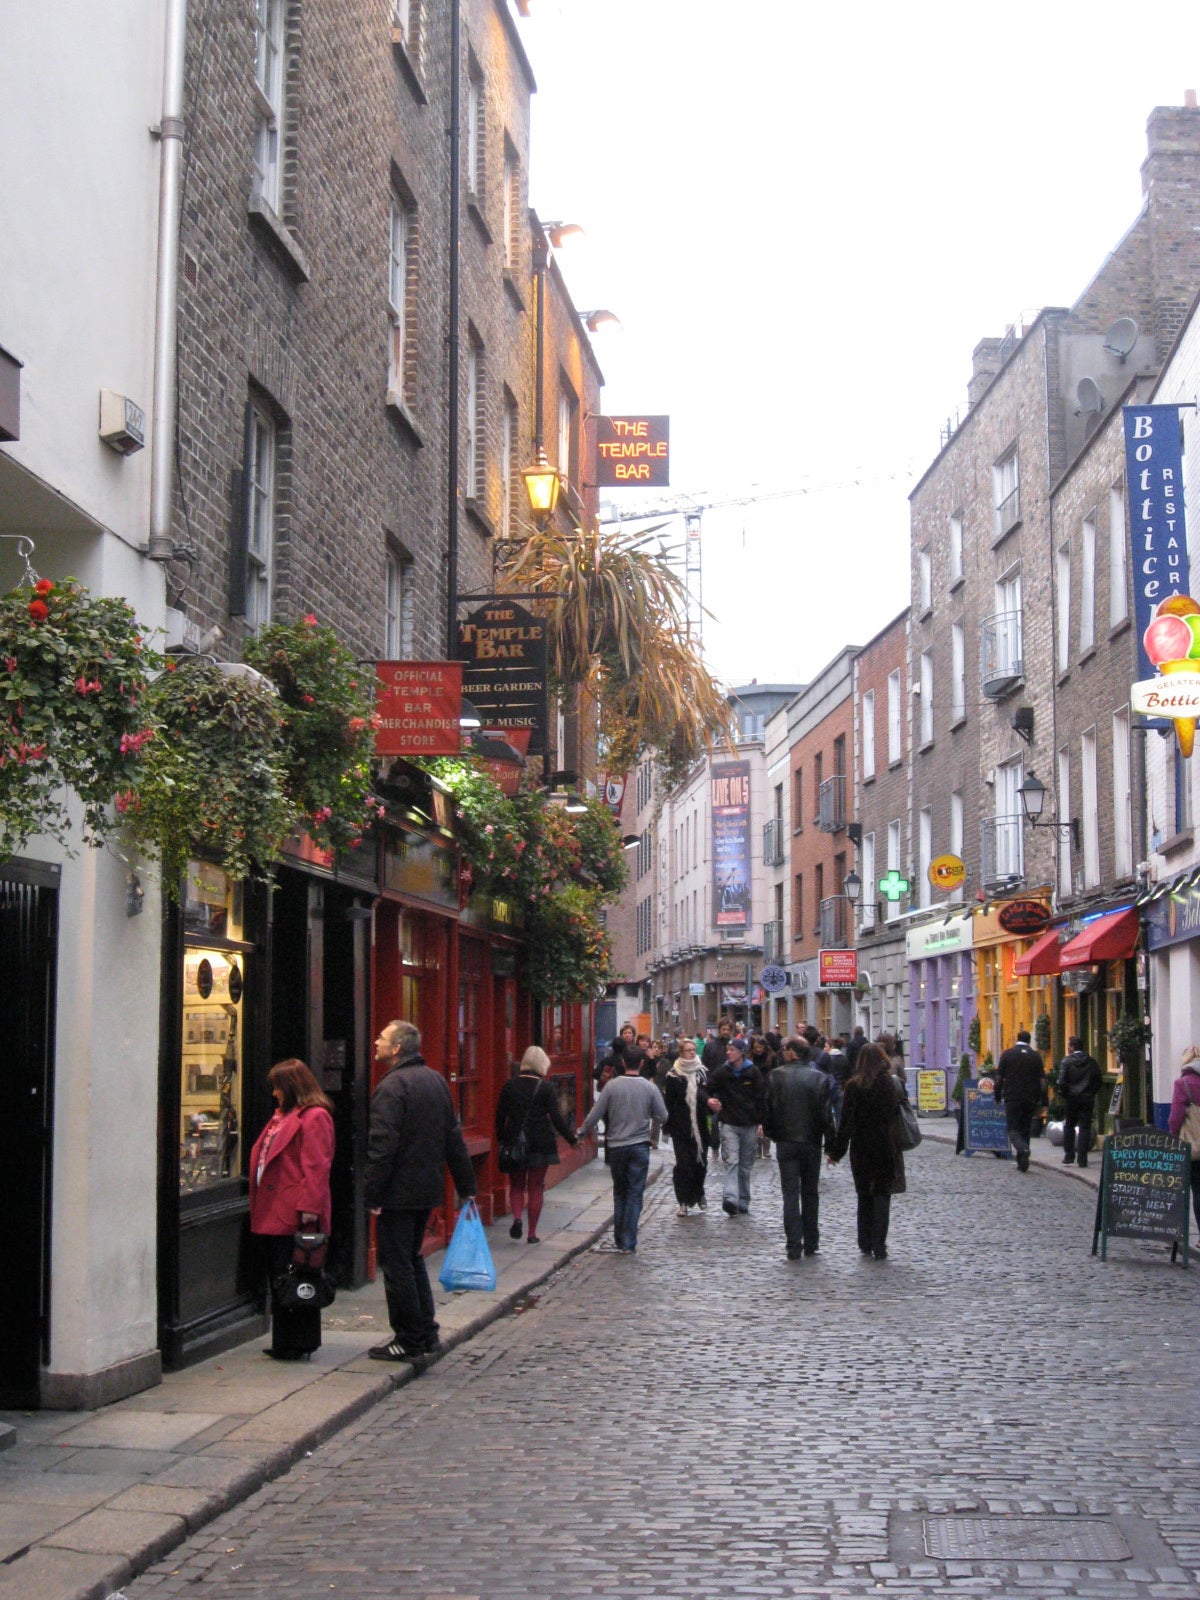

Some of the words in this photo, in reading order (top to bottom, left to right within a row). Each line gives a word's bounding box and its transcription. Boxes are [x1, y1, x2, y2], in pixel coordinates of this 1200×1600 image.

[613, 420, 648, 436] THE
[598, 441, 667, 458] TEMPLE
[615, 464, 650, 478] BAR
[484, 610, 515, 621] THE
[460, 624, 543, 643] TEMPLE
[476, 640, 525, 659] BAR
[394, 670, 443, 682] OFFICIAL
[393, 686, 444, 697] TEMPLE
[461, 684, 491, 693] BEER
[493, 682, 542, 692] GARDEN
[404, 702, 432, 713] BAR
[380, 718, 458, 730] MERCHANDISE
[497, 716, 537, 727] MUSIC
[400, 735, 436, 746] STORE
[1113, 1133, 1182, 1151] BOTTICELLI
[1115, 1160, 1136, 1169] TWO
[1139, 1160, 1181, 1172] COURSES
[1114, 1171, 1138, 1181] FROM
